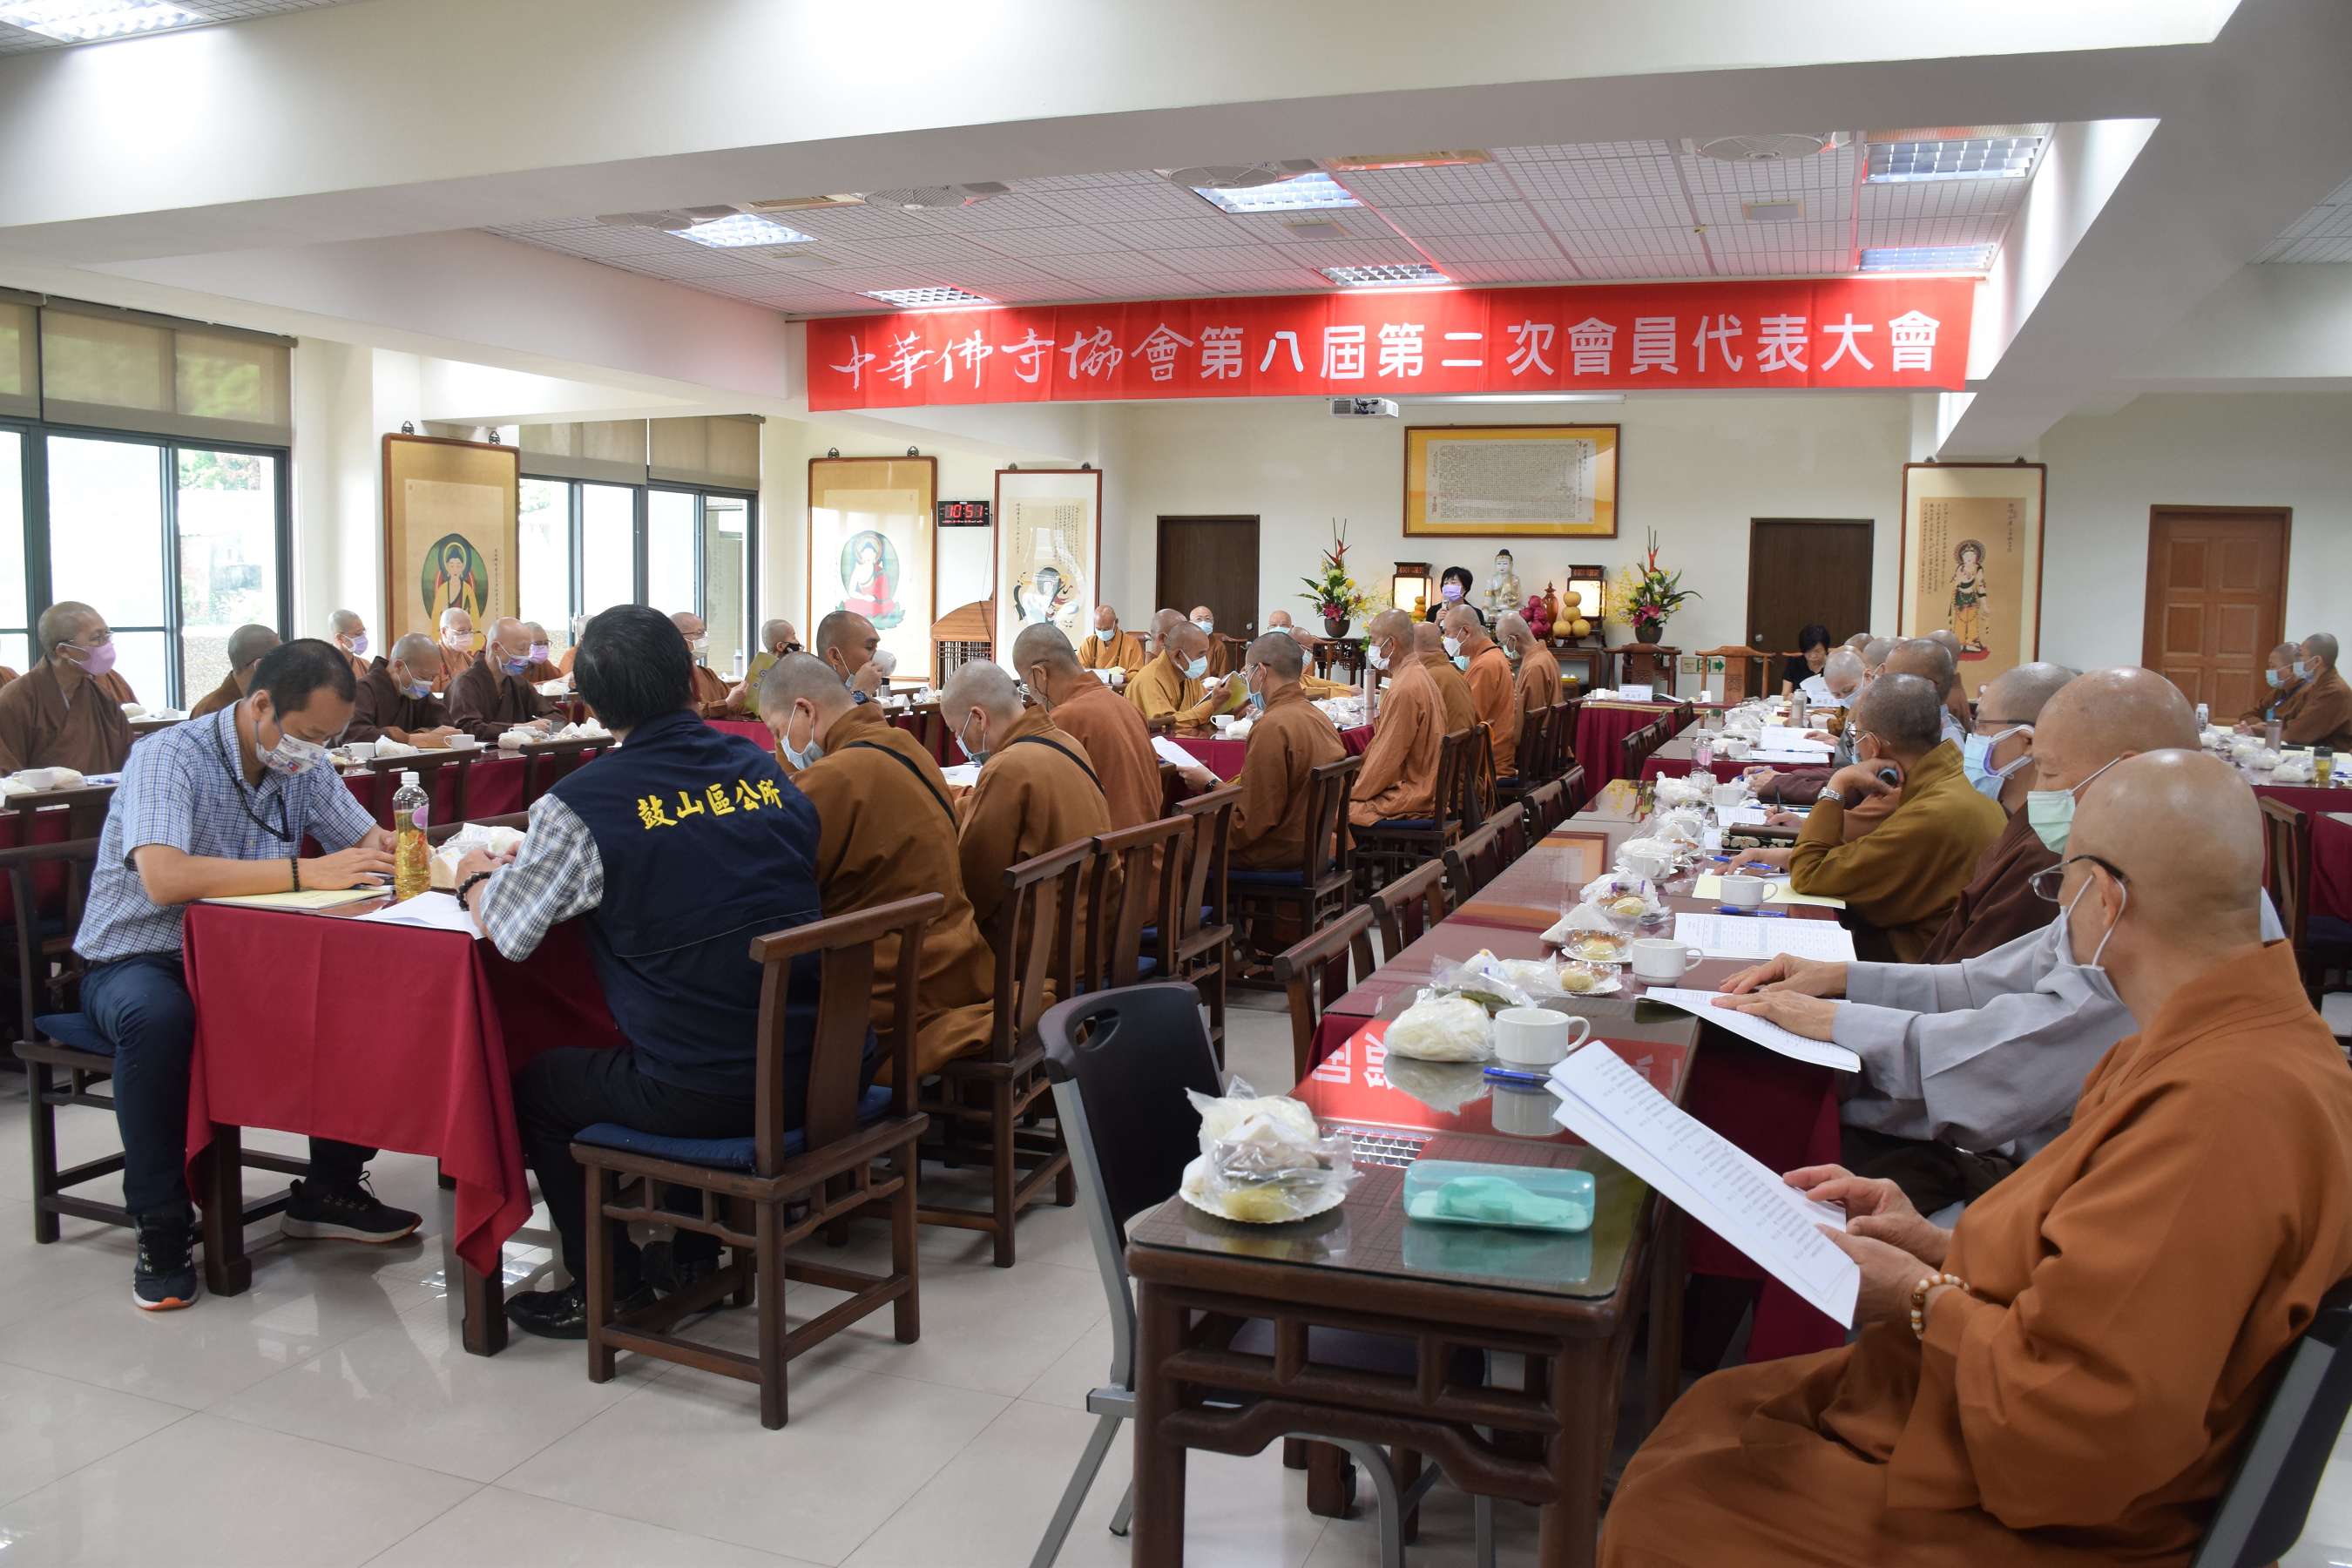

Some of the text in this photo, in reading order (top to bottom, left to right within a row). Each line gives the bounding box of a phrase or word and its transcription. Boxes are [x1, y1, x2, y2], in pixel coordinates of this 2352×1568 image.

[828, 309, 1942, 391] 中華佛寺協會第八屆第二次會員代表大會
[637, 779, 782, 830] 鼓山區公所
